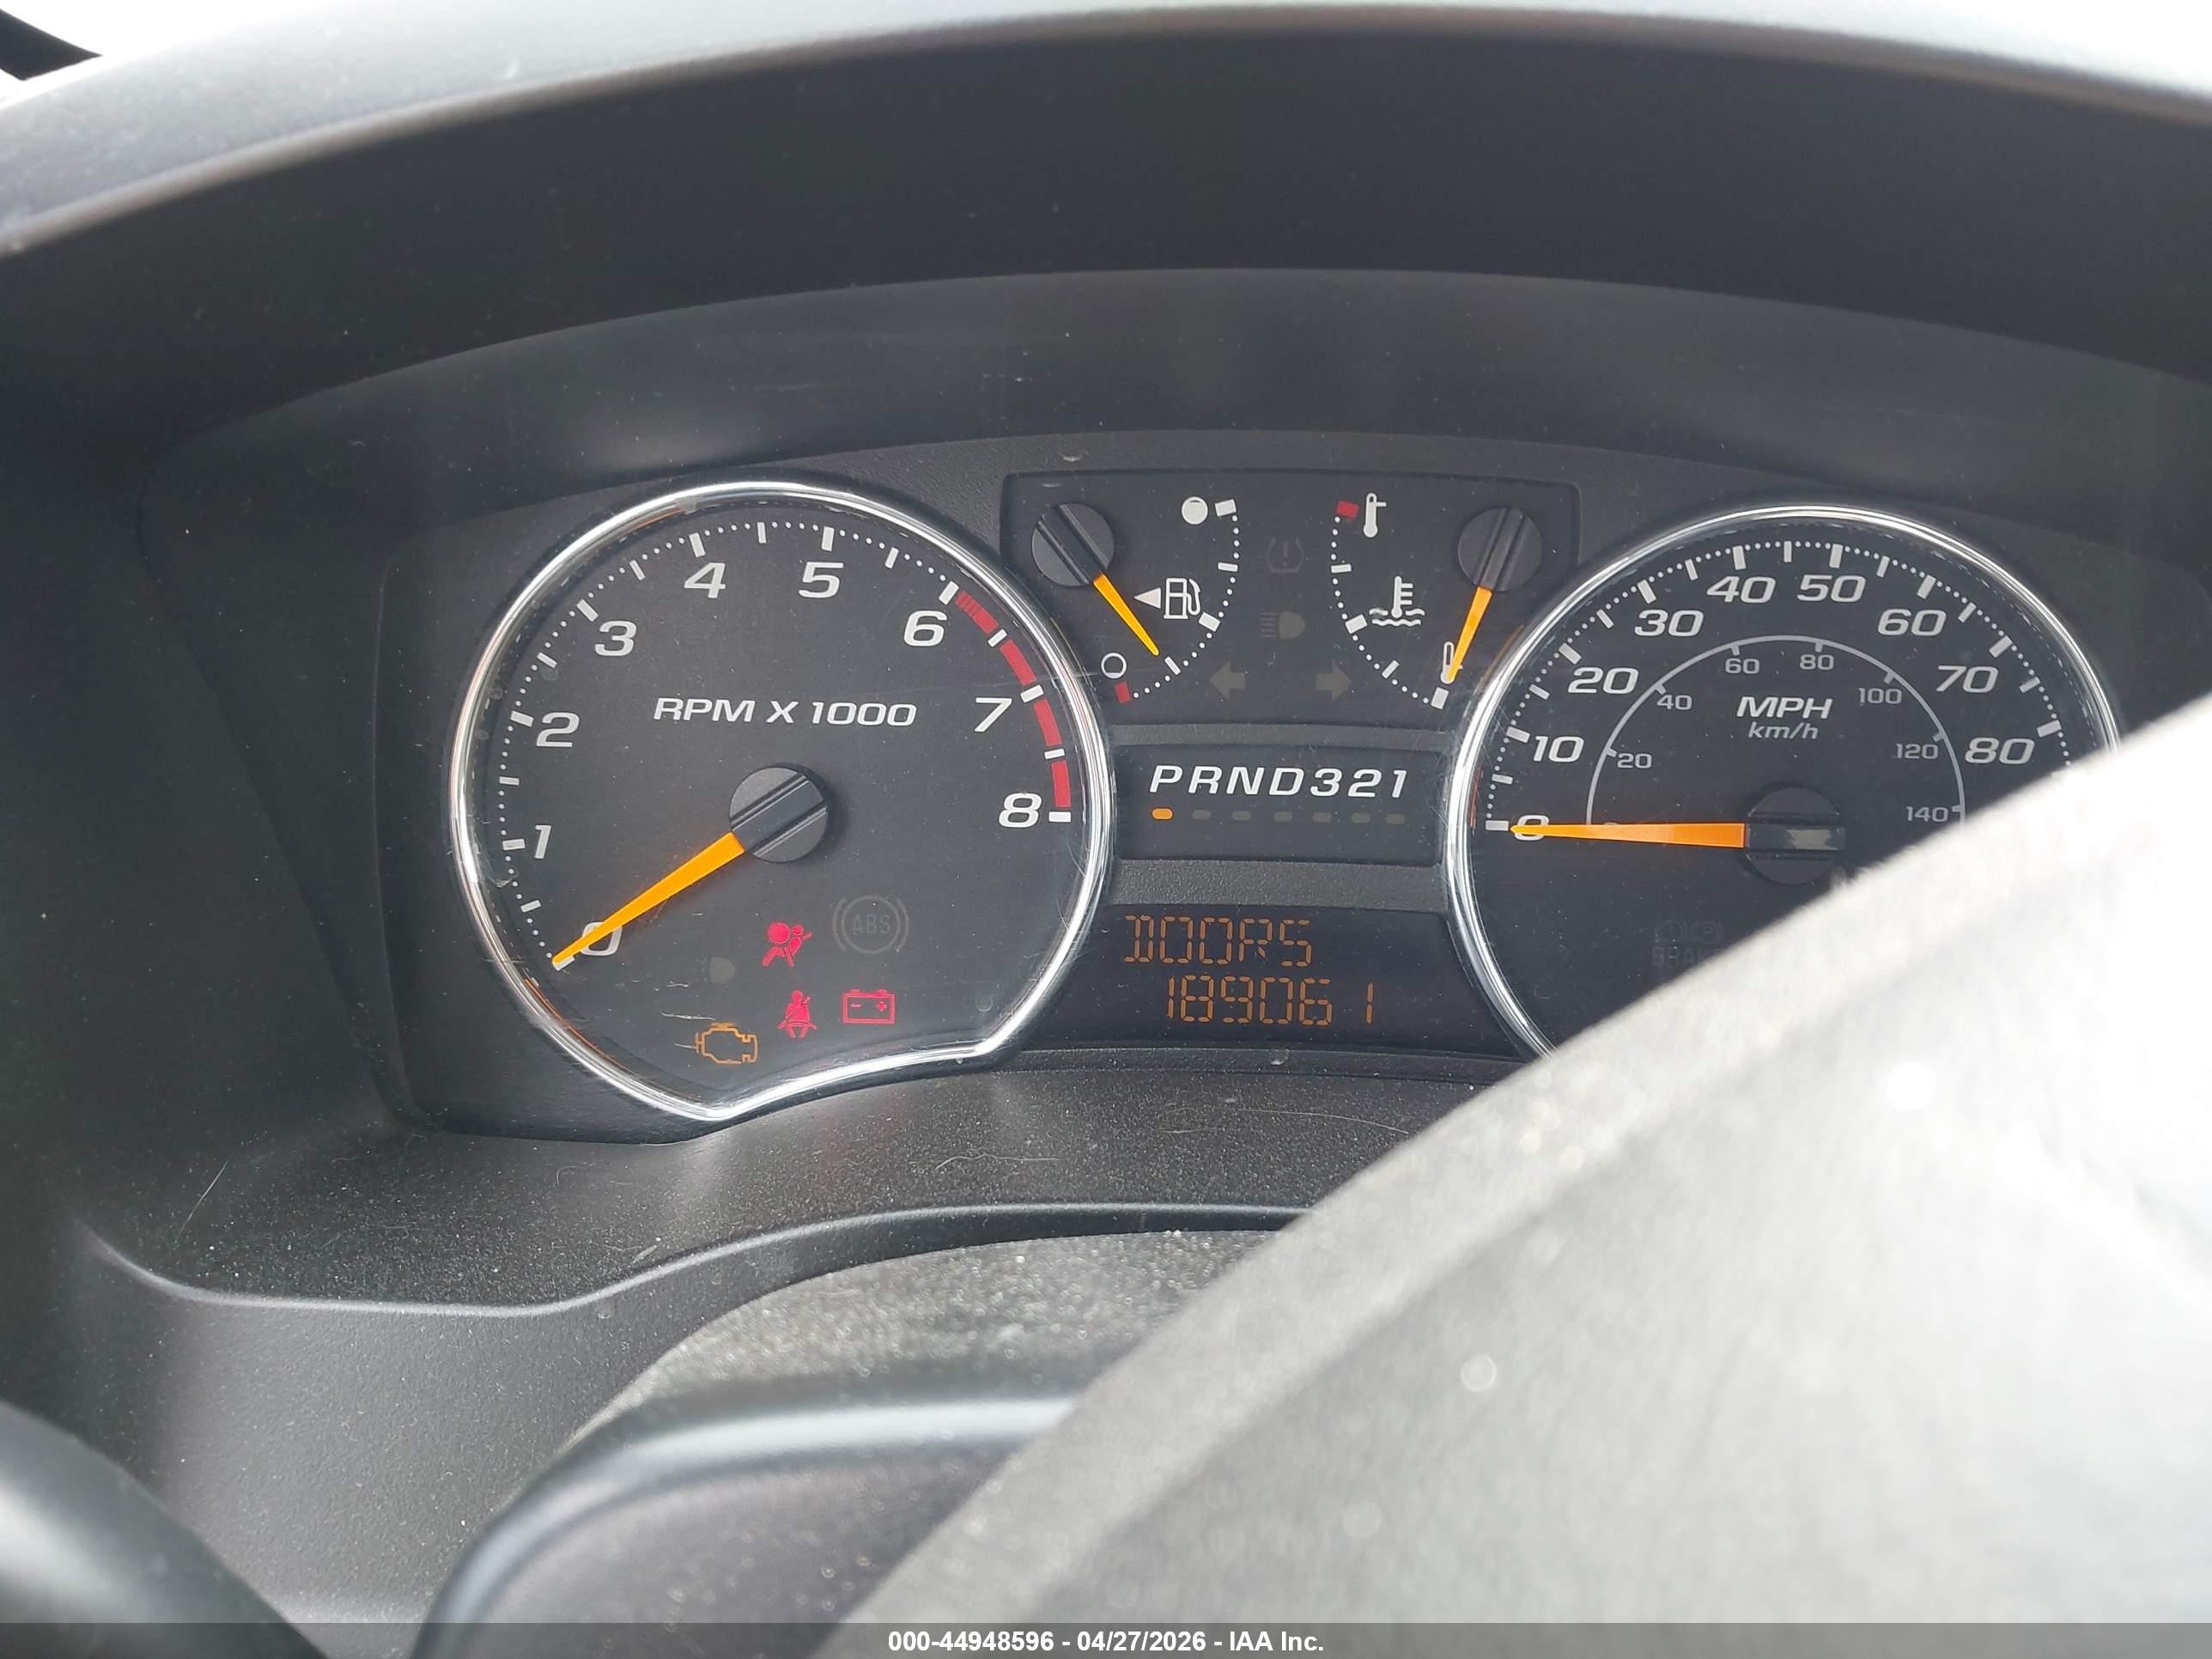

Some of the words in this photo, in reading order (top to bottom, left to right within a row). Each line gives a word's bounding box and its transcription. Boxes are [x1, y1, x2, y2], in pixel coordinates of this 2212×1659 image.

[684, 562, 726, 599] 4
[799, 562, 843, 599] 5
[1707, 575, 1776, 604] 40
[1796, 574, 1865, 603] 50
[904, 611, 947, 647] 6
[1634, 610, 1704, 637] 30
[1877, 609, 1947, 636] 60
[594, 621, 636, 657] 3
[1725, 655, 1760, 675] 60
[1799, 653, 1834, 672] 80
[1568, 666, 1639, 695] 20
[1936, 665, 1999, 693] 70
[1656, 693, 1692, 711] 40
[1736, 696, 1833, 720] MPH
[1858, 687, 1903, 706] 100
[653, 697, 756, 723] RPM
[766, 701, 799, 723] X
[812, 702, 917, 726] 1000
[974, 697, 1012, 732] 7
[536, 712, 580, 748] 2
[1747, 721, 1819, 742] km/h
[1533, 735, 1584, 763] 10
[1617, 751, 1652, 769] 20
[1895, 743, 1939, 759] 120
[1965, 737, 2035, 764] 80
[999, 793, 1042, 828] 8
[1905, 805, 1948, 823] 140
[534, 824, 552, 860] 1
[852, 914, 891, 934] ABS
[1123, 914, 1313, 969] DOORS
